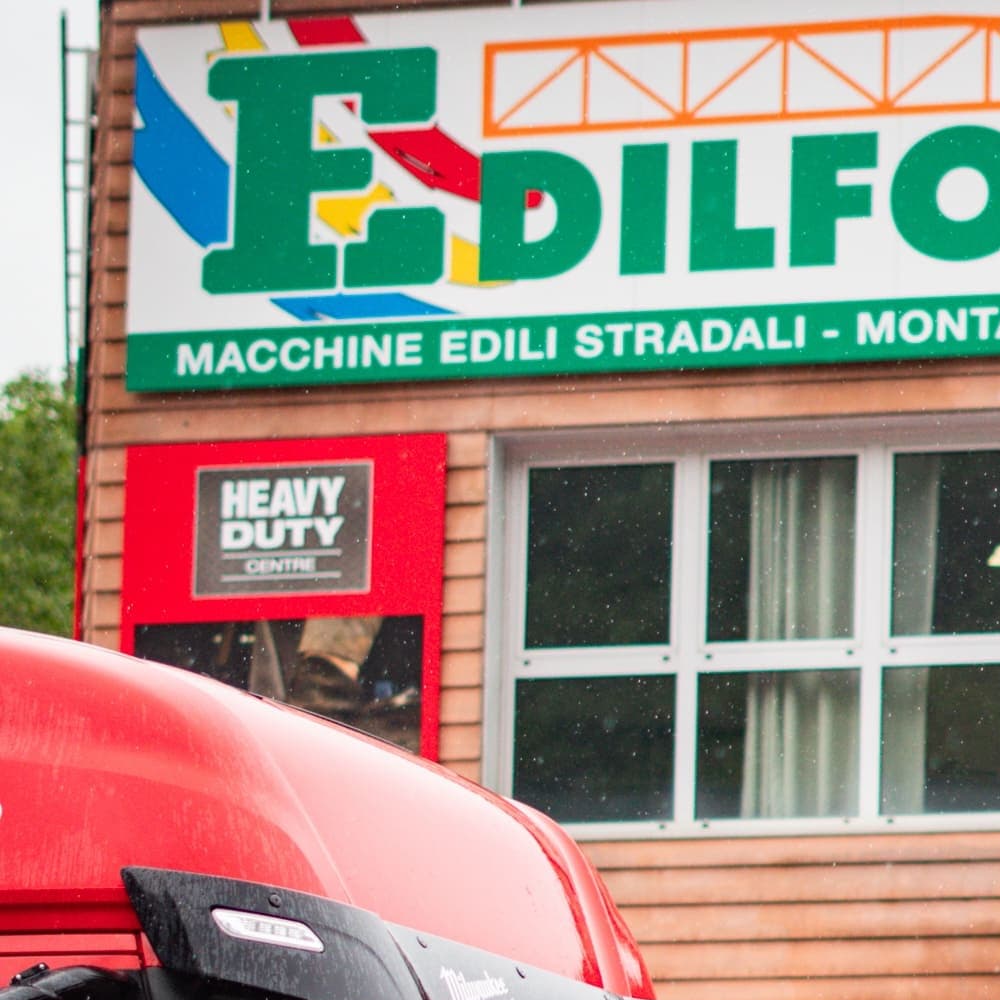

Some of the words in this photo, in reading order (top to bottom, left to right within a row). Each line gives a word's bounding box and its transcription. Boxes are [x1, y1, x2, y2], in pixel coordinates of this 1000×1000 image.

[176, 332, 423, 376] MACCHINE
[439, 326, 557, 364] EDILI
[574, 315, 806, 358] STRADALI
[221, 475, 345, 519] HEAVY
[220, 516, 344, 550] DUTY
[244, 556, 317, 574] CENTRE
